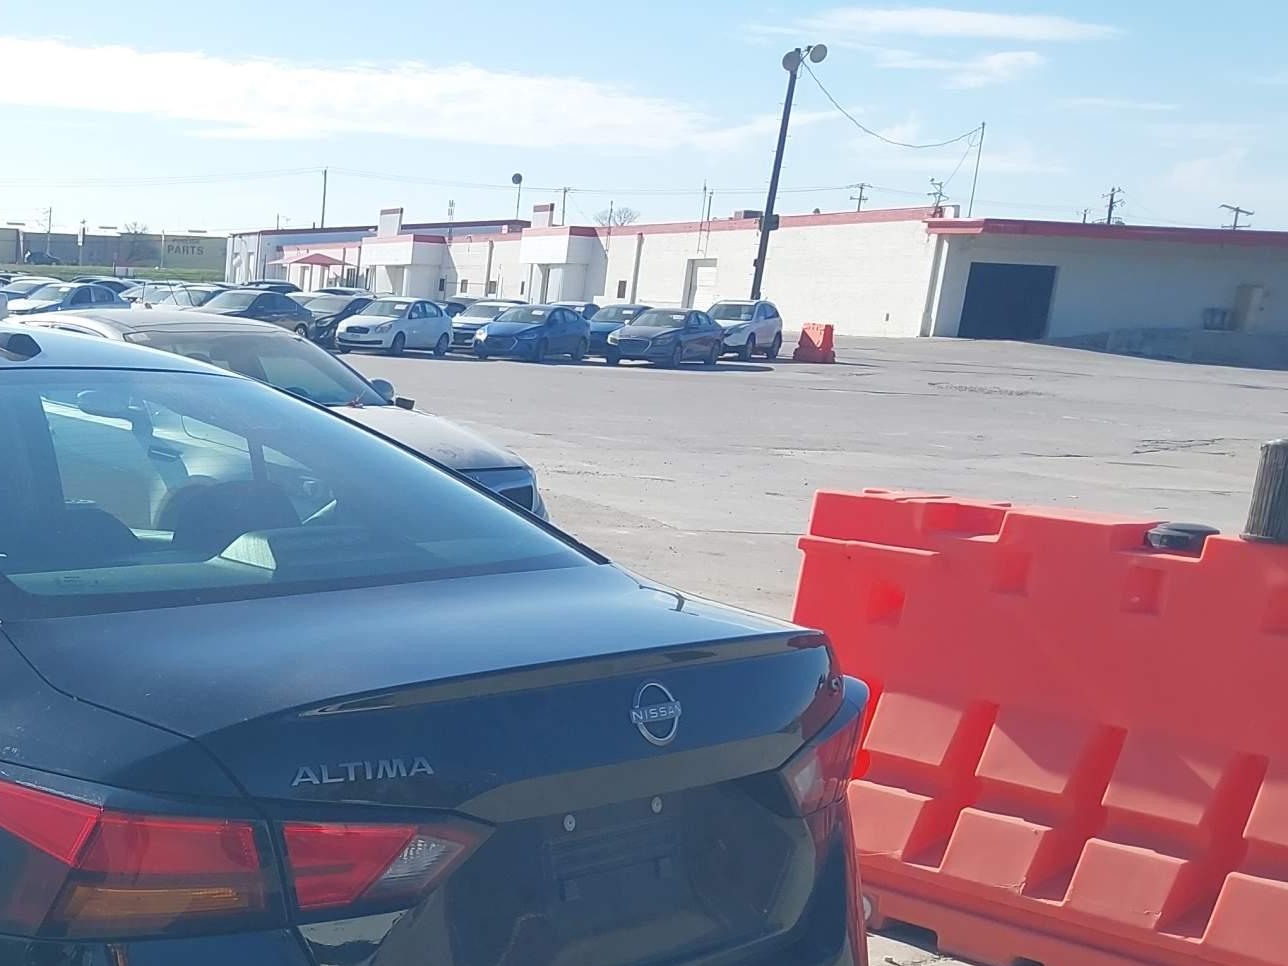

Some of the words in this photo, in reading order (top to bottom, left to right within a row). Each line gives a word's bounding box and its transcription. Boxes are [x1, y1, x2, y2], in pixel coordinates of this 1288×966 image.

[167, 244, 204, 256] PARTS
[631, 703, 682, 721] NISSAN
[291, 756, 435, 786] ALTIMA
